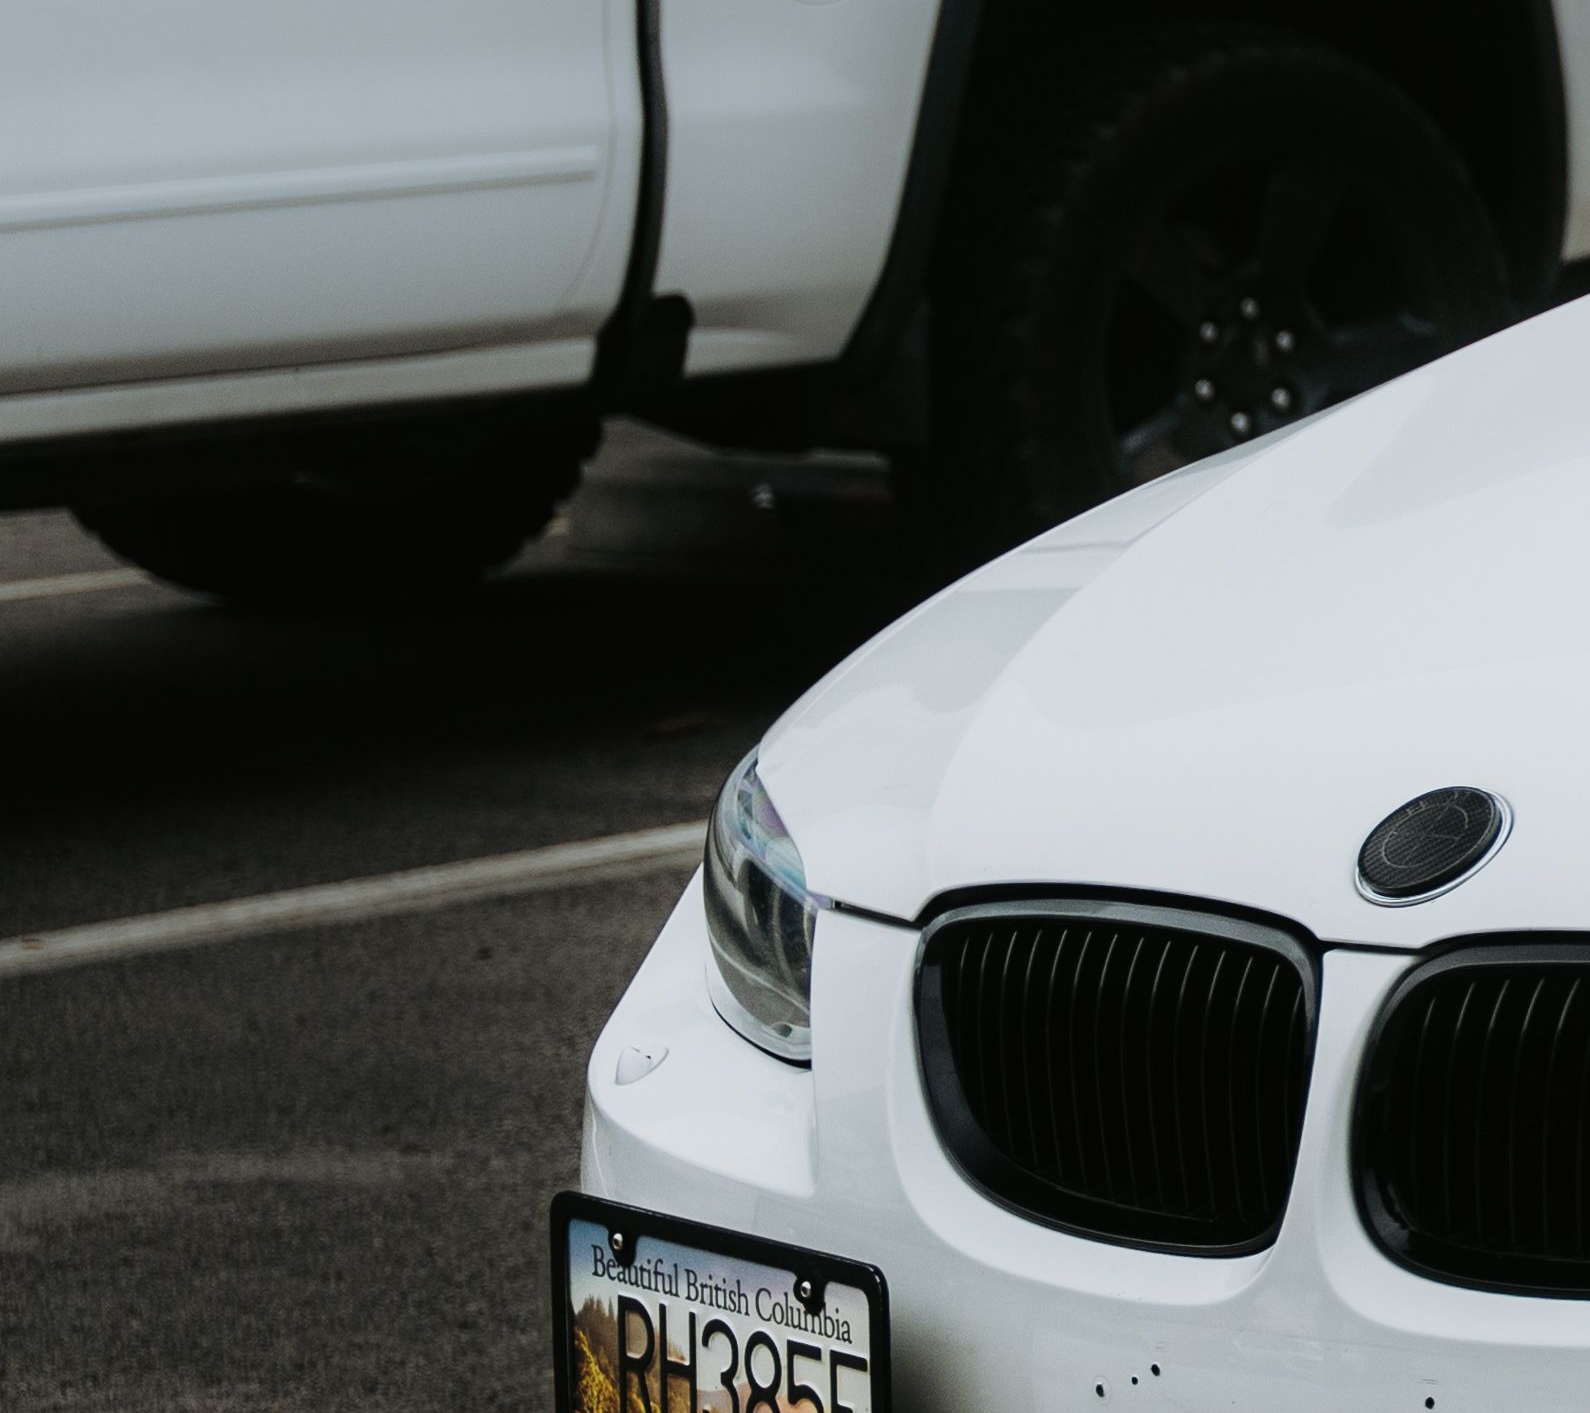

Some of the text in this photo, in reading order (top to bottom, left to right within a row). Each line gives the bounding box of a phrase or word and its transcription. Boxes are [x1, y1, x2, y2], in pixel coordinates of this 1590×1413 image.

[591, 1244, 853, 1345] Beautiful British Columbia
